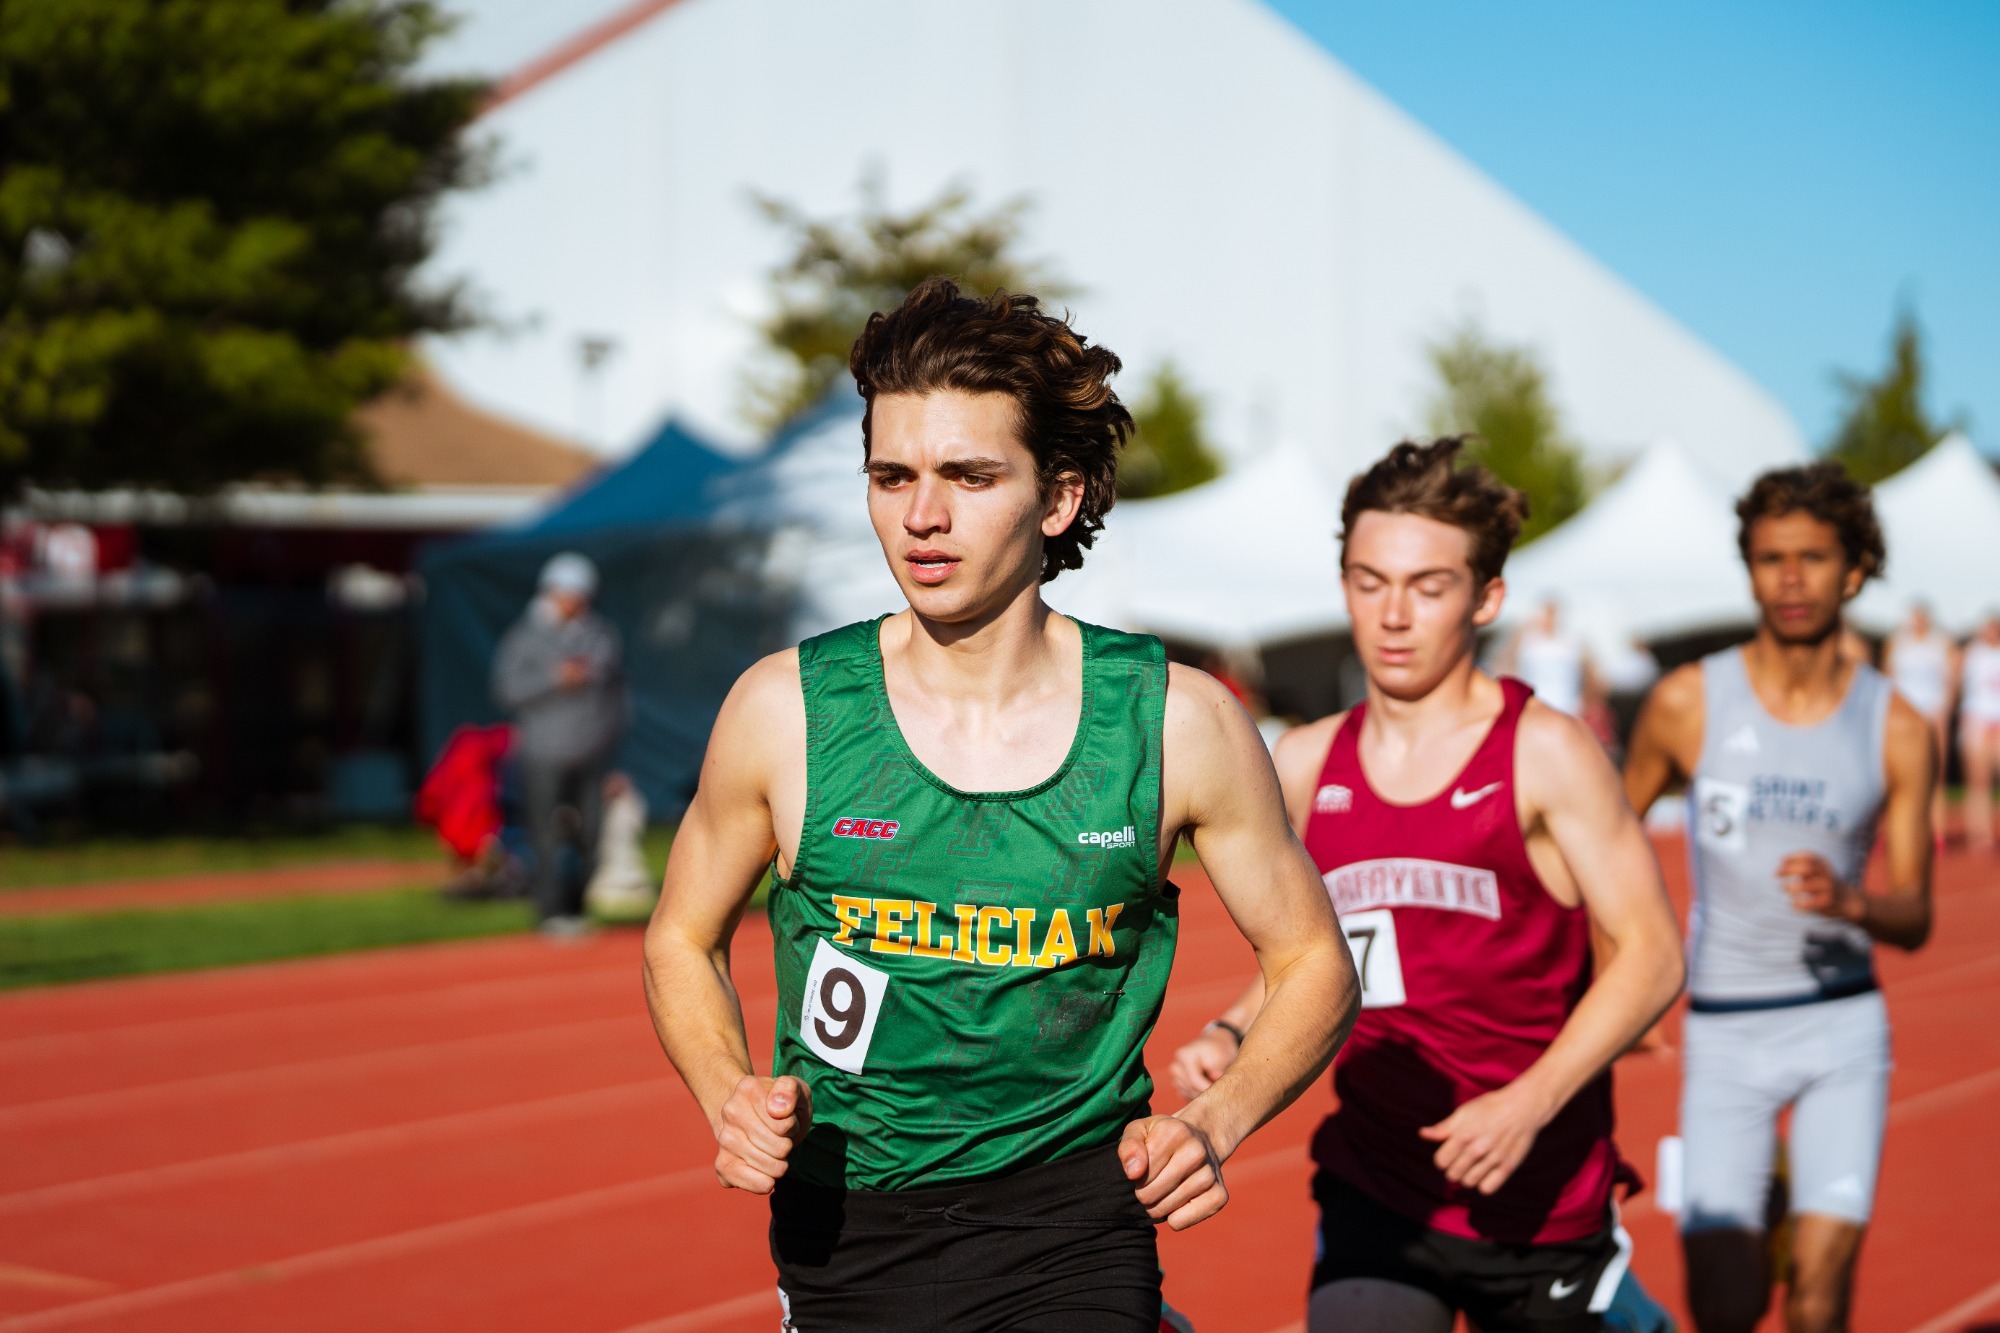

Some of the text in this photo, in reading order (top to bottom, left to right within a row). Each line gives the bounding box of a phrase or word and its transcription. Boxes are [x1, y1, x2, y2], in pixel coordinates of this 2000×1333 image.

[832, 817, 900, 840] CACC
[1078, 826, 1135, 848] capelli
[1107, 841, 1135, 849] SPORT
[832, 894, 1125, 968] FELICIAN
[1348, 928, 1378, 992] 7
[814, 967, 867, 1050] 9
